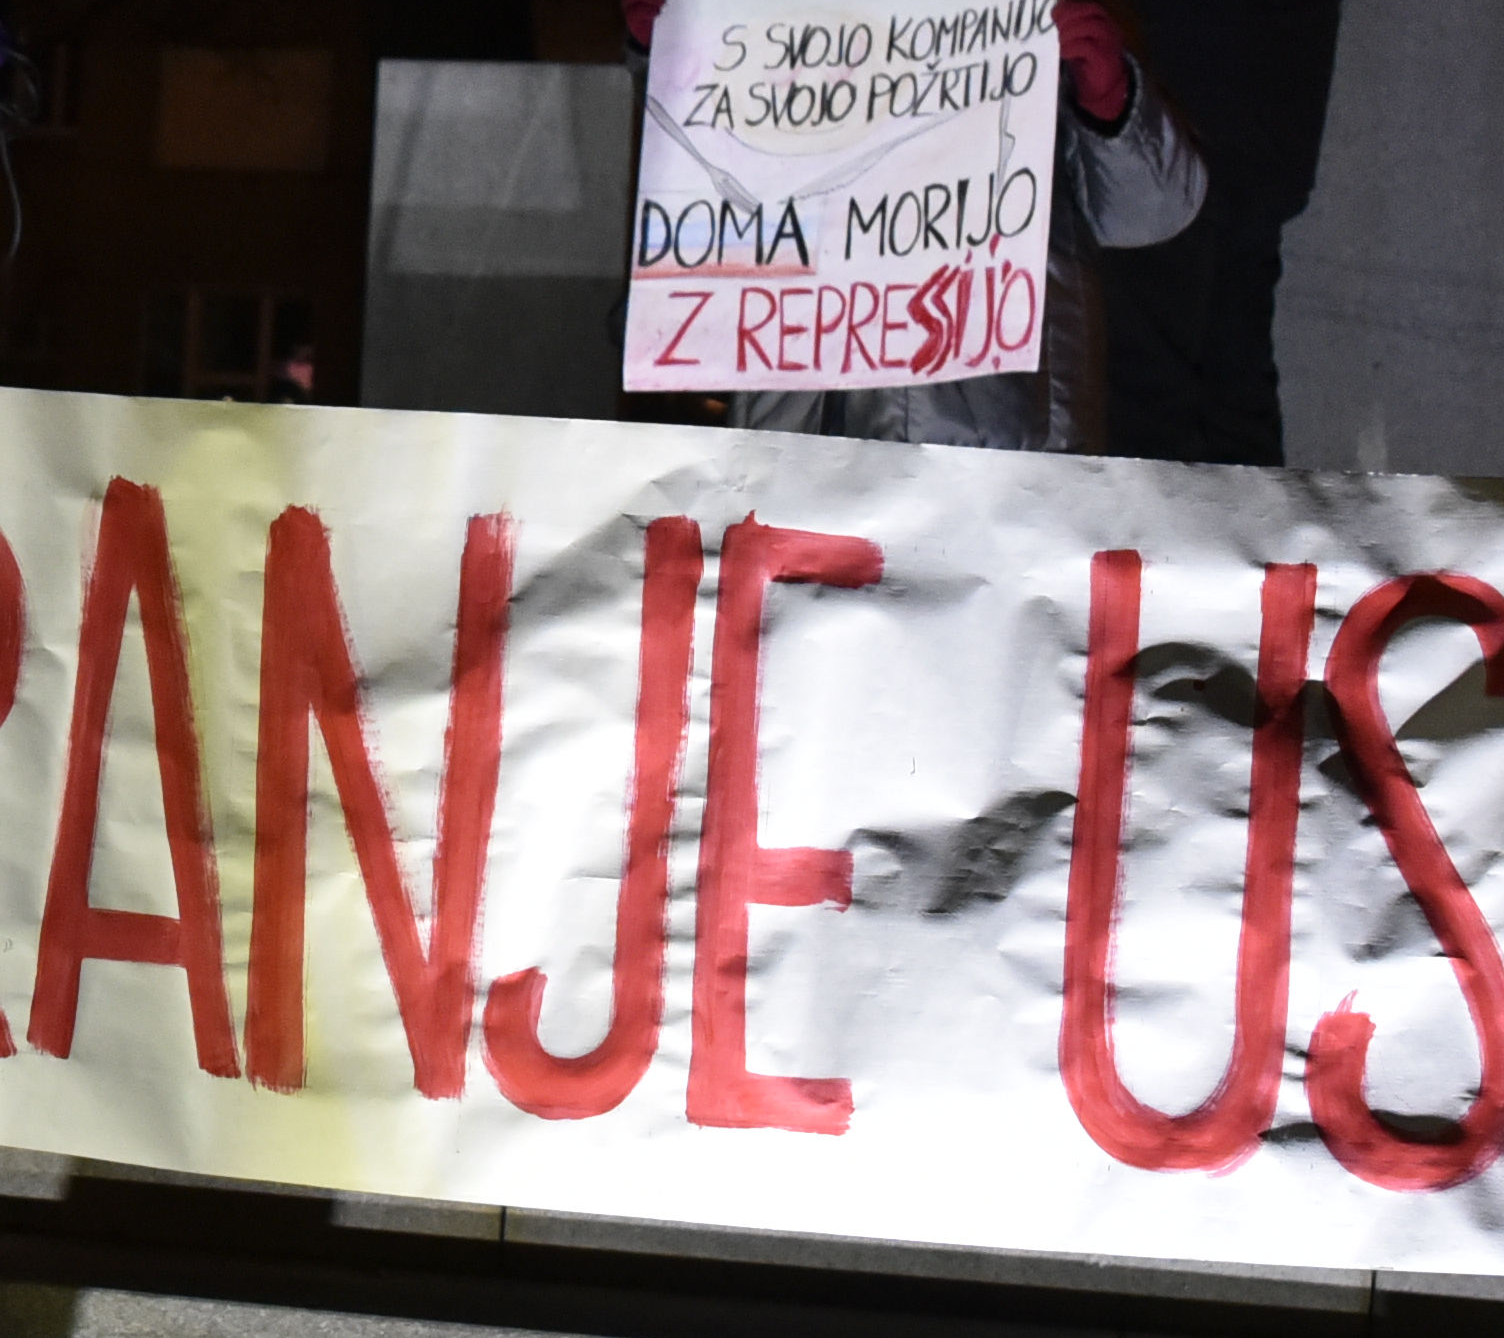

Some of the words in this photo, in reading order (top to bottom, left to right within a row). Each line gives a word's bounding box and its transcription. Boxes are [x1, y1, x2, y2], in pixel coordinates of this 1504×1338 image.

[712, 24, 748, 71] S
[763, 22, 873, 71] SVOJO
[683, 82, 734, 129] ZA
[749, 79, 856, 129] SVOJO
[866, 51, 1038, 122] POŽRTIJO
[637, 198, 810, 269] DOMA
[844, 167, 1038, 262] MORIJO
[653, 290, 722, 367] Z
